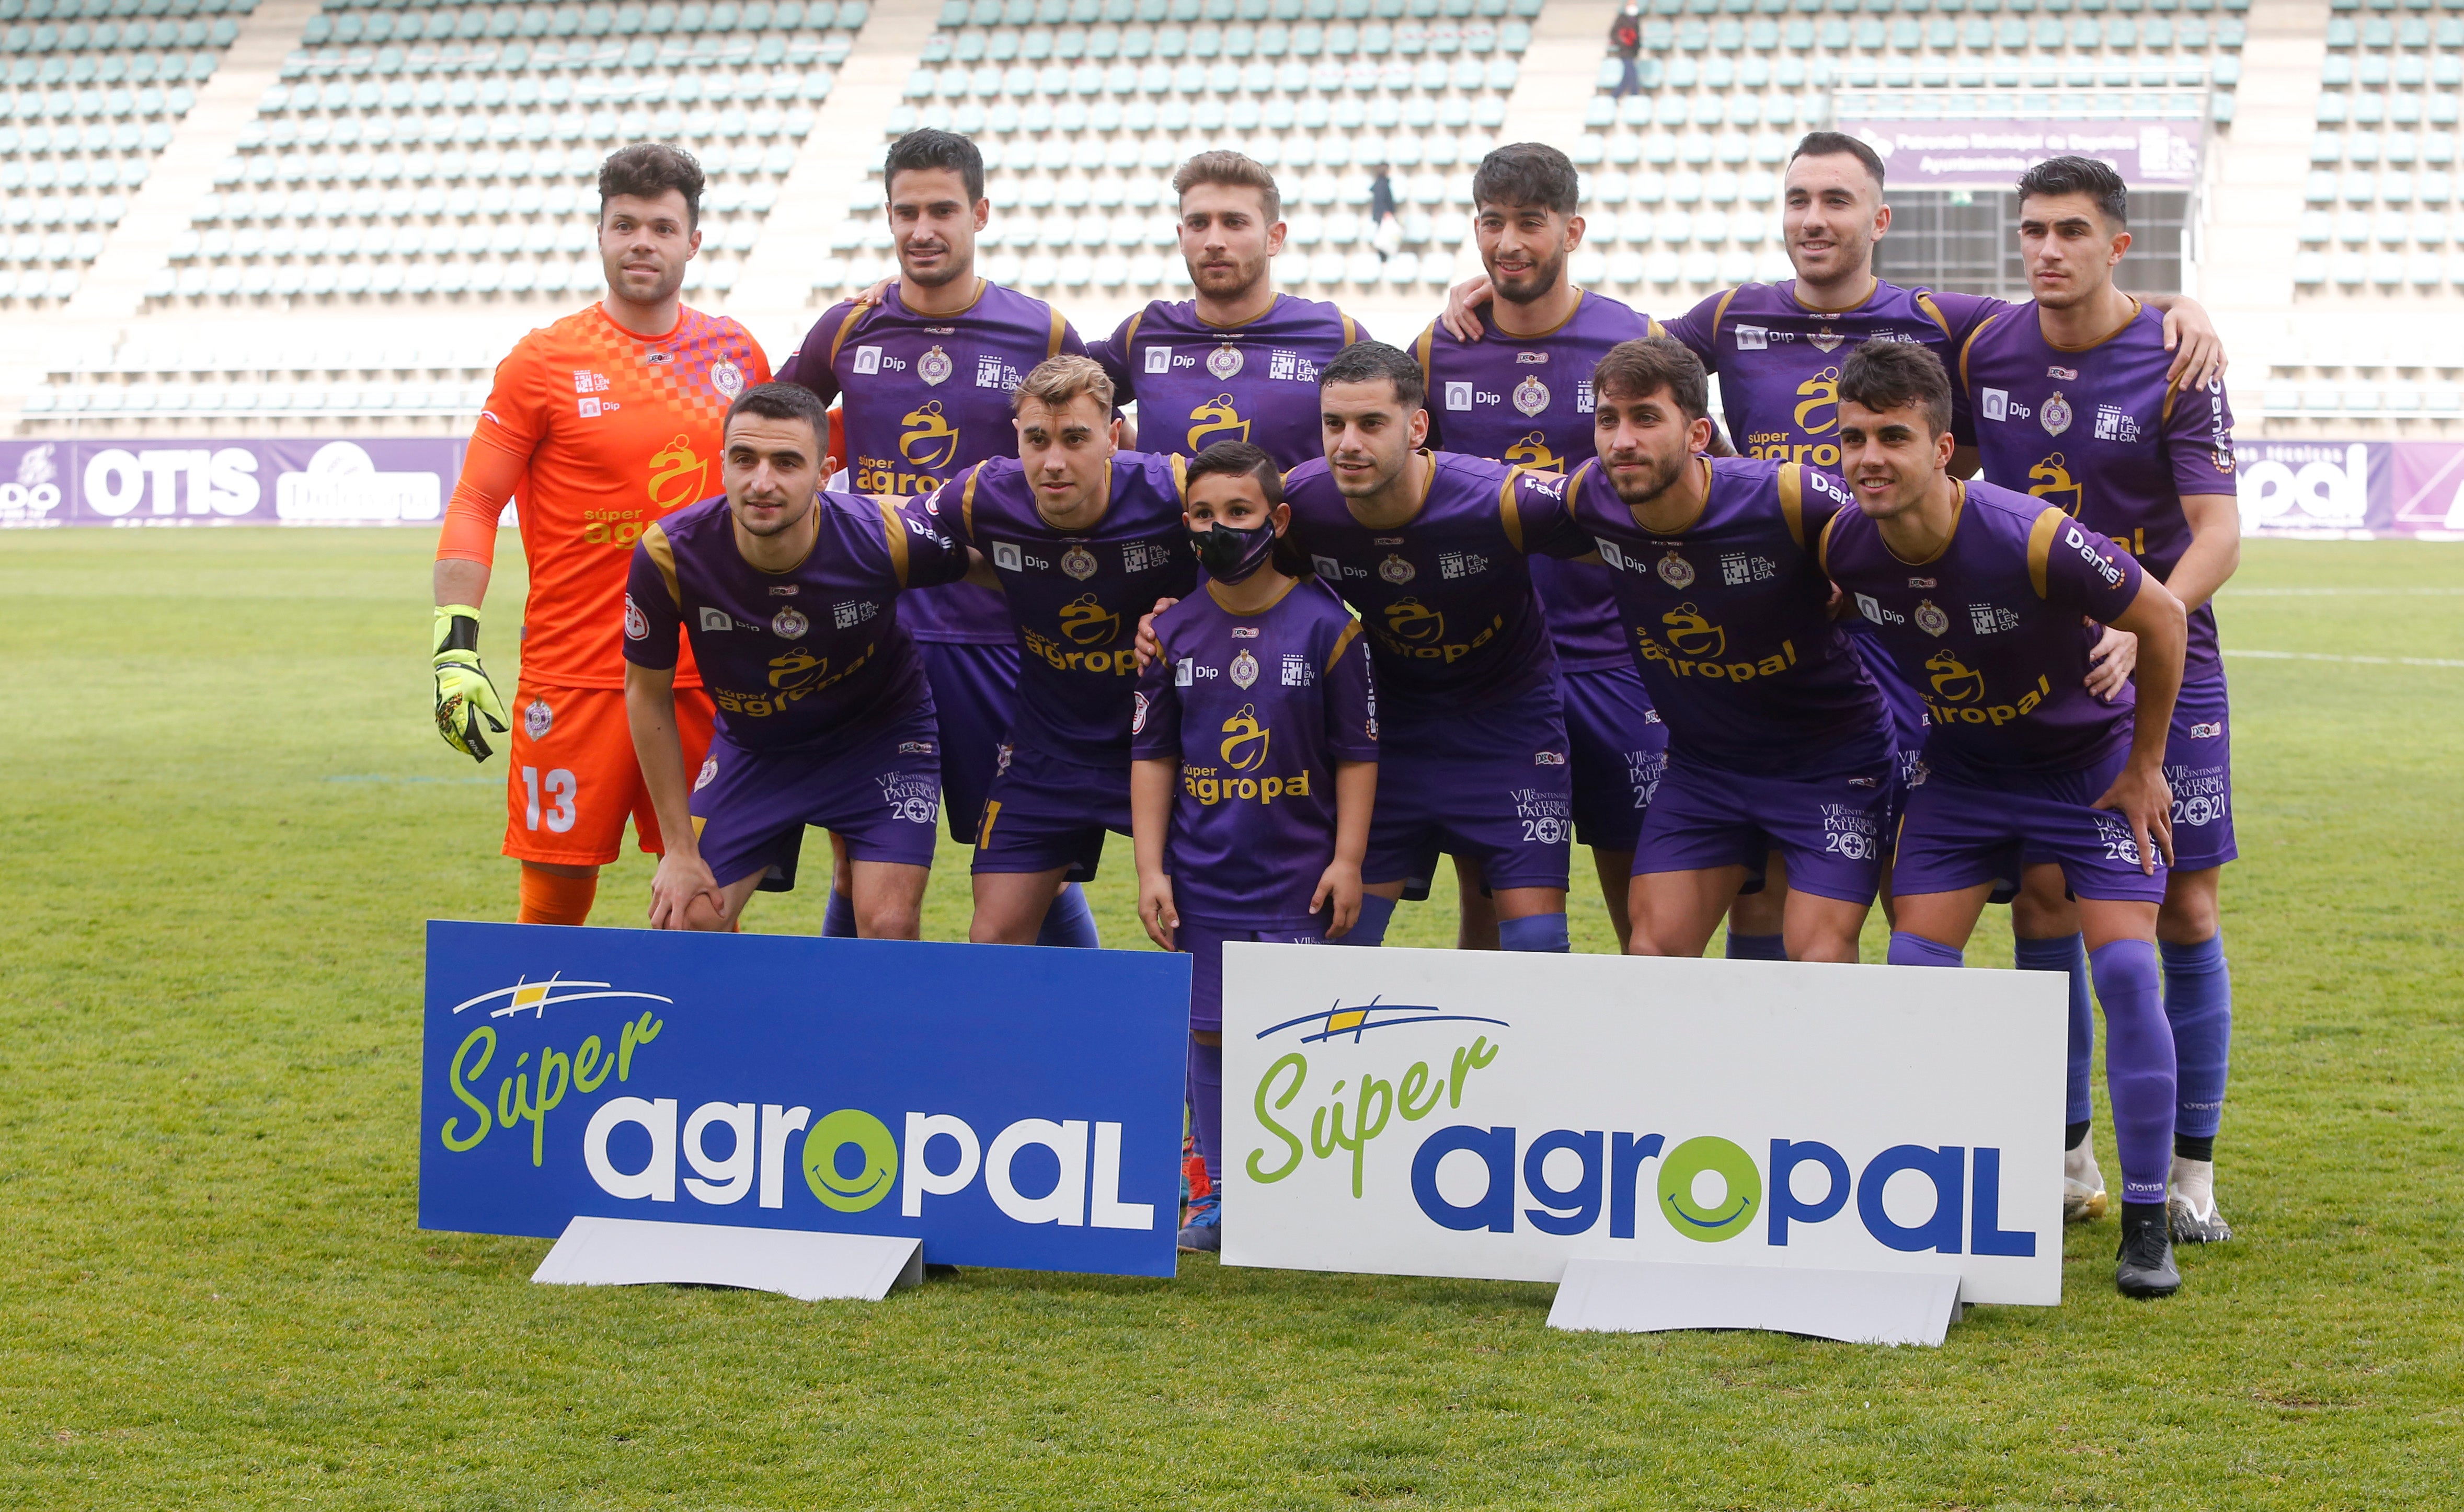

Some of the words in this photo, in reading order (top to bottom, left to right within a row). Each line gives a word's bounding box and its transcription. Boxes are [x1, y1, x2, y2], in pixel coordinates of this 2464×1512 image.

[883, 356, 907, 372] Dip
[1173, 355, 1196, 369] Dip
[1299, 359, 1313, 367] PA
[1003, 366, 1017, 374] PA
[1298, 366, 1319, 376] LEN
[1002, 373, 1023, 383] LEN
[1297, 374, 1315, 383] CIA
[1476, 391, 1501, 406] Dip
[603, 401, 620, 411] Dip
[2010, 402, 2031, 420] Dip
[2121, 415, 2135, 425] PA
[2121, 424, 2140, 435] LEN
[1748, 431, 1790, 444] súper
[2119, 434, 2137, 443] CIA
[858, 455, 895, 469] súper
[84, 448, 261, 516] OTIS
[856, 468, 953, 495] agro
[583, 507, 643, 523] súper
[1150, 545, 1163, 553] PA
[1150, 549, 1171, 561] LEN
[1025, 555, 1049, 570] Dip
[1152, 558, 1169, 567] CIA
[1466, 554, 1480, 563] PA
[1467, 557, 1488, 569] LEN
[1624, 555, 1647, 573] Dip
[1750, 557, 1766, 565] PA
[1343, 566, 1368, 579] Dip
[1469, 564, 1487, 574] CIA
[1752, 561, 1775, 572] LEN
[1754, 570, 1775, 580] CIA
[859, 601, 873, 609] PA
[860, 603, 879, 616] LEN
[862, 611, 878, 621] CIA
[1883, 609, 1905, 625] Dip
[1996, 608, 2010, 617] PA
[1998, 612, 2019, 624] LEN
[2000, 621, 2019, 631] CIA
[718, 641, 875, 718] agropal
[1195, 666, 1219, 680] Dip
[1304, 671, 1315, 679] LEN
[714, 687, 767, 700] súper
[1183, 764, 1218, 778] súper
[1185, 769, 1310, 805] agropal
[2169, 781, 2225, 797] PALENCIA
[522, 766, 577, 833] 13
[883, 787, 937, 802] PALENCIA
[1517, 804, 1570, 818] PALENCIA
[1824, 817, 1877, 836] PALENCIA
[441, 1010, 663, 1168] Súper
[1245, 1036, 1499, 1199] Súper
